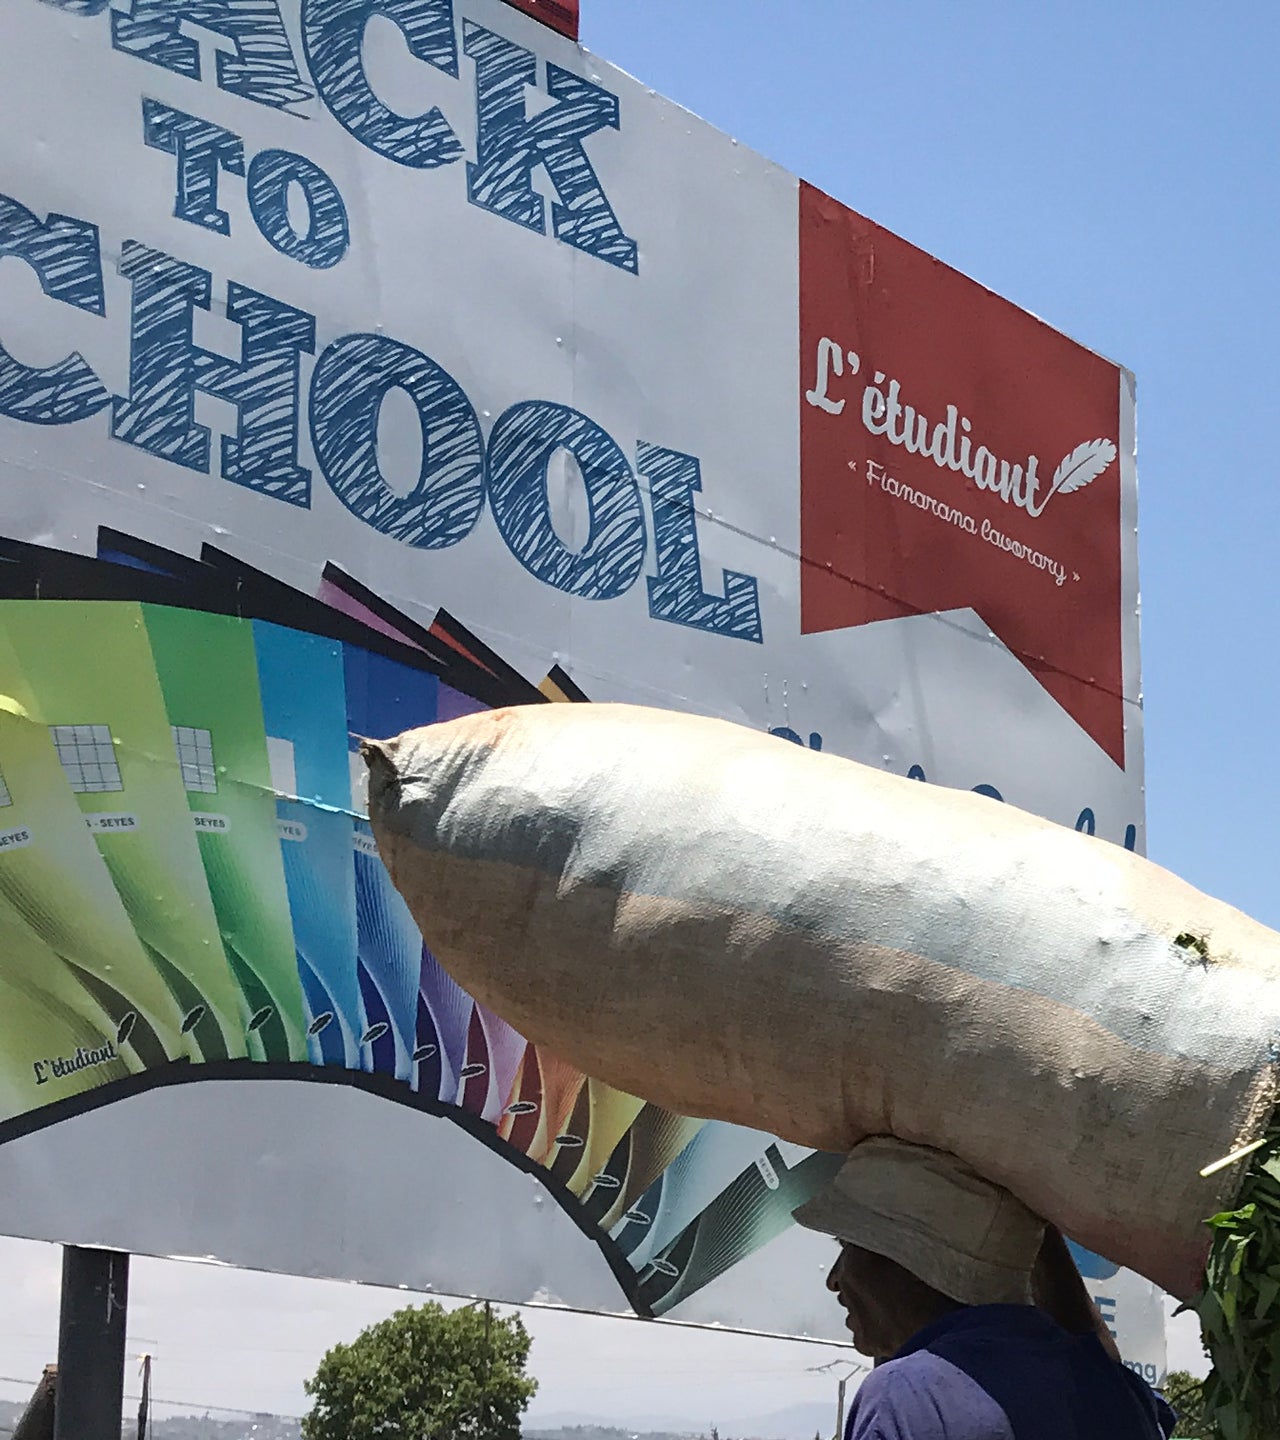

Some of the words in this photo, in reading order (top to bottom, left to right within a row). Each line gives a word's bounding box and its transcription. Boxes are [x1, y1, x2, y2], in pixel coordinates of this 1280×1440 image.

[143, 94, 349, 269] TO
[806, 337, 1043, 517] L'étudiant
[866, 459, 978, 535] Fianarana
[194, 816, 226, 829] SEYES
[33, 1041, 117, 1085] L'étudiant
